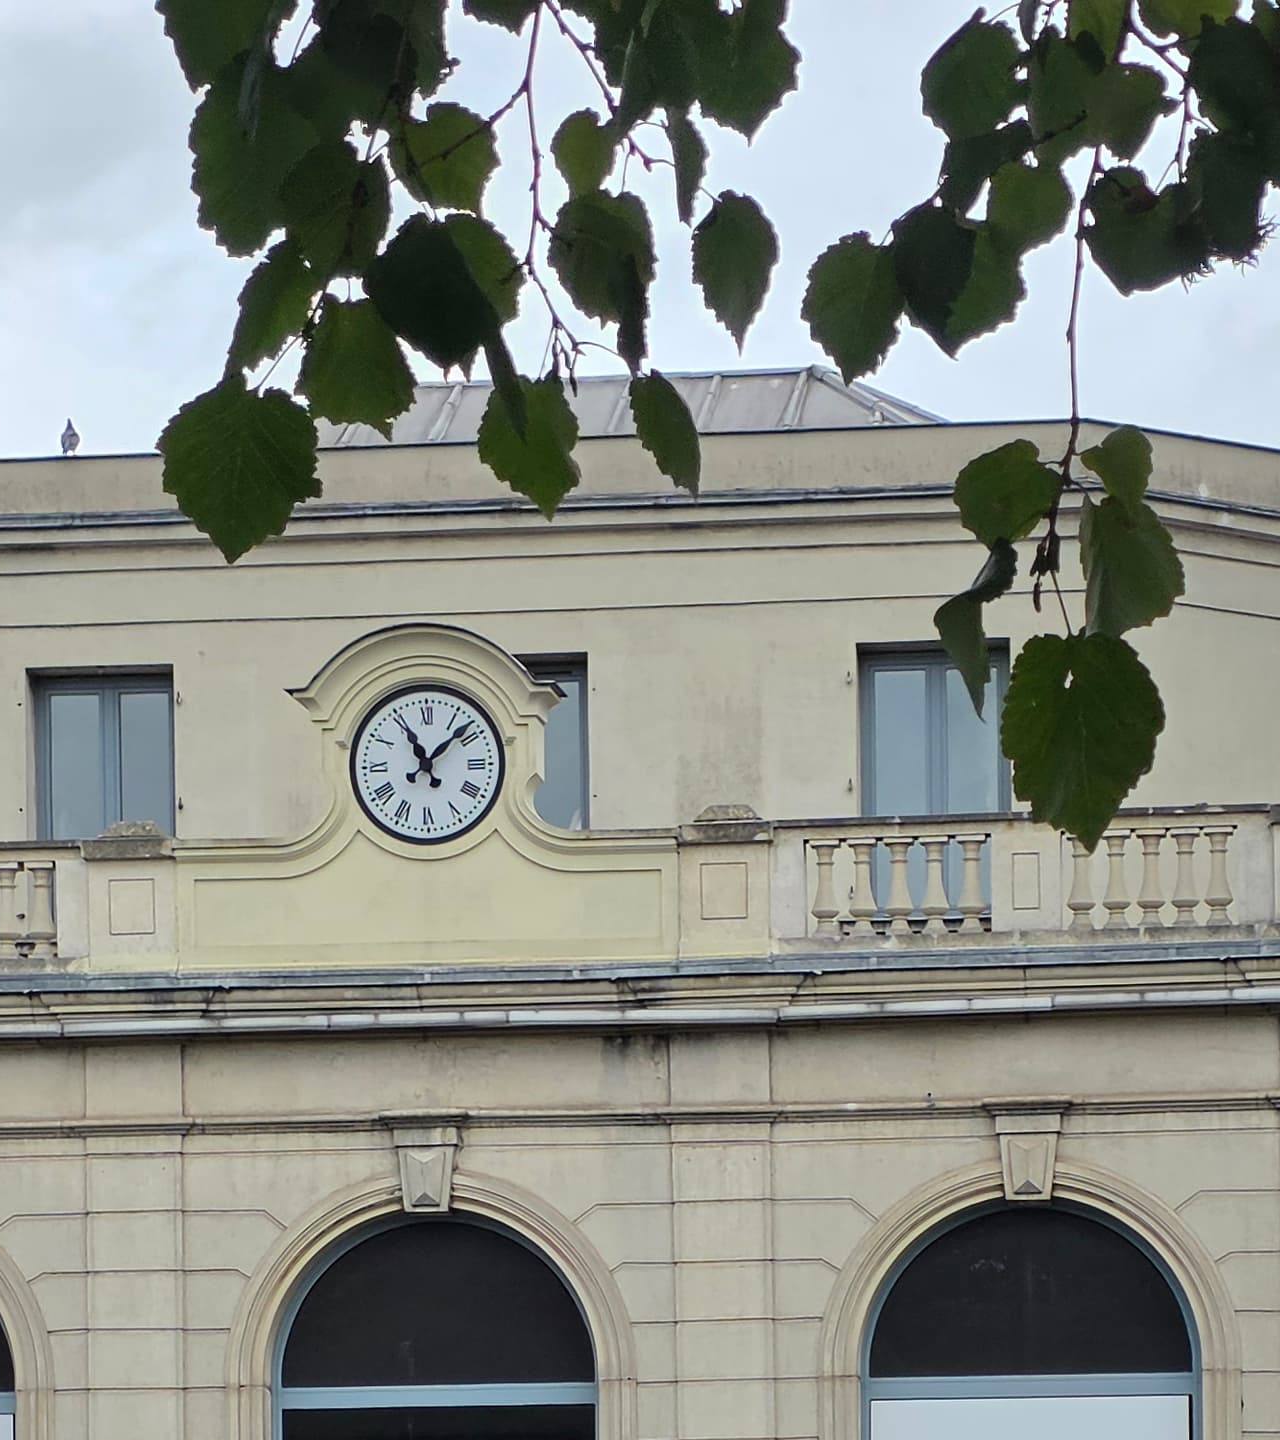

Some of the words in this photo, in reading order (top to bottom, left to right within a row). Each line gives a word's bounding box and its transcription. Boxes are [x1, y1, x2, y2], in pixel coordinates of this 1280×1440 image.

[421, 707, 433, 725] XII
[376, 735, 394, 749] X
[461, 732, 479, 747] II
[370, 761, 388, 772] IX
[468, 759, 486, 770] III
[423, 807, 434, 825] VI
[448, 801, 461, 818] V
